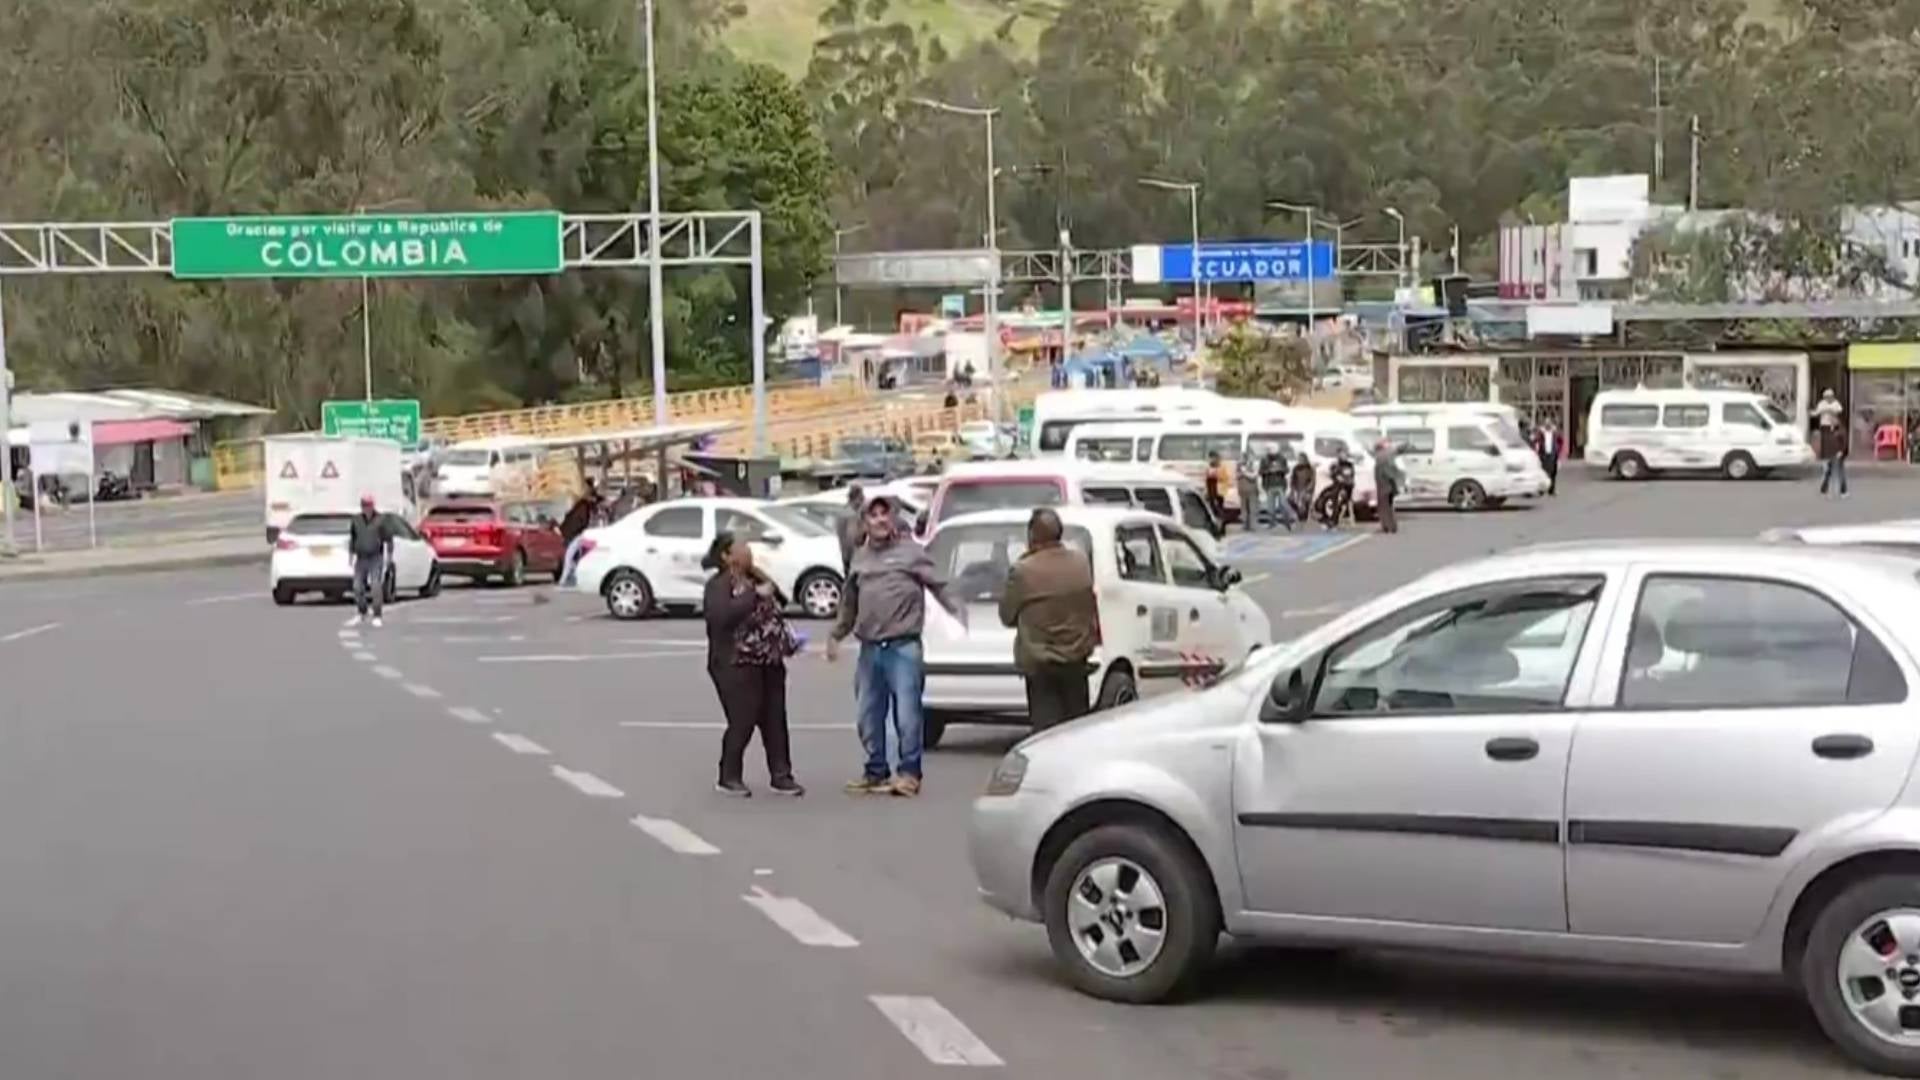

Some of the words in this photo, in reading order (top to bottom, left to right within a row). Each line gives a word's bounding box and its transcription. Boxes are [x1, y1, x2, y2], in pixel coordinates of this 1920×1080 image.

[226, 222, 286, 236] Gracias
[290, 223, 317, 238] por
[323, 221, 373, 235] visitar
[377, 221, 393, 235] la
[483, 218, 503, 234] de
[261, 238, 468, 268] COLOMBIA
